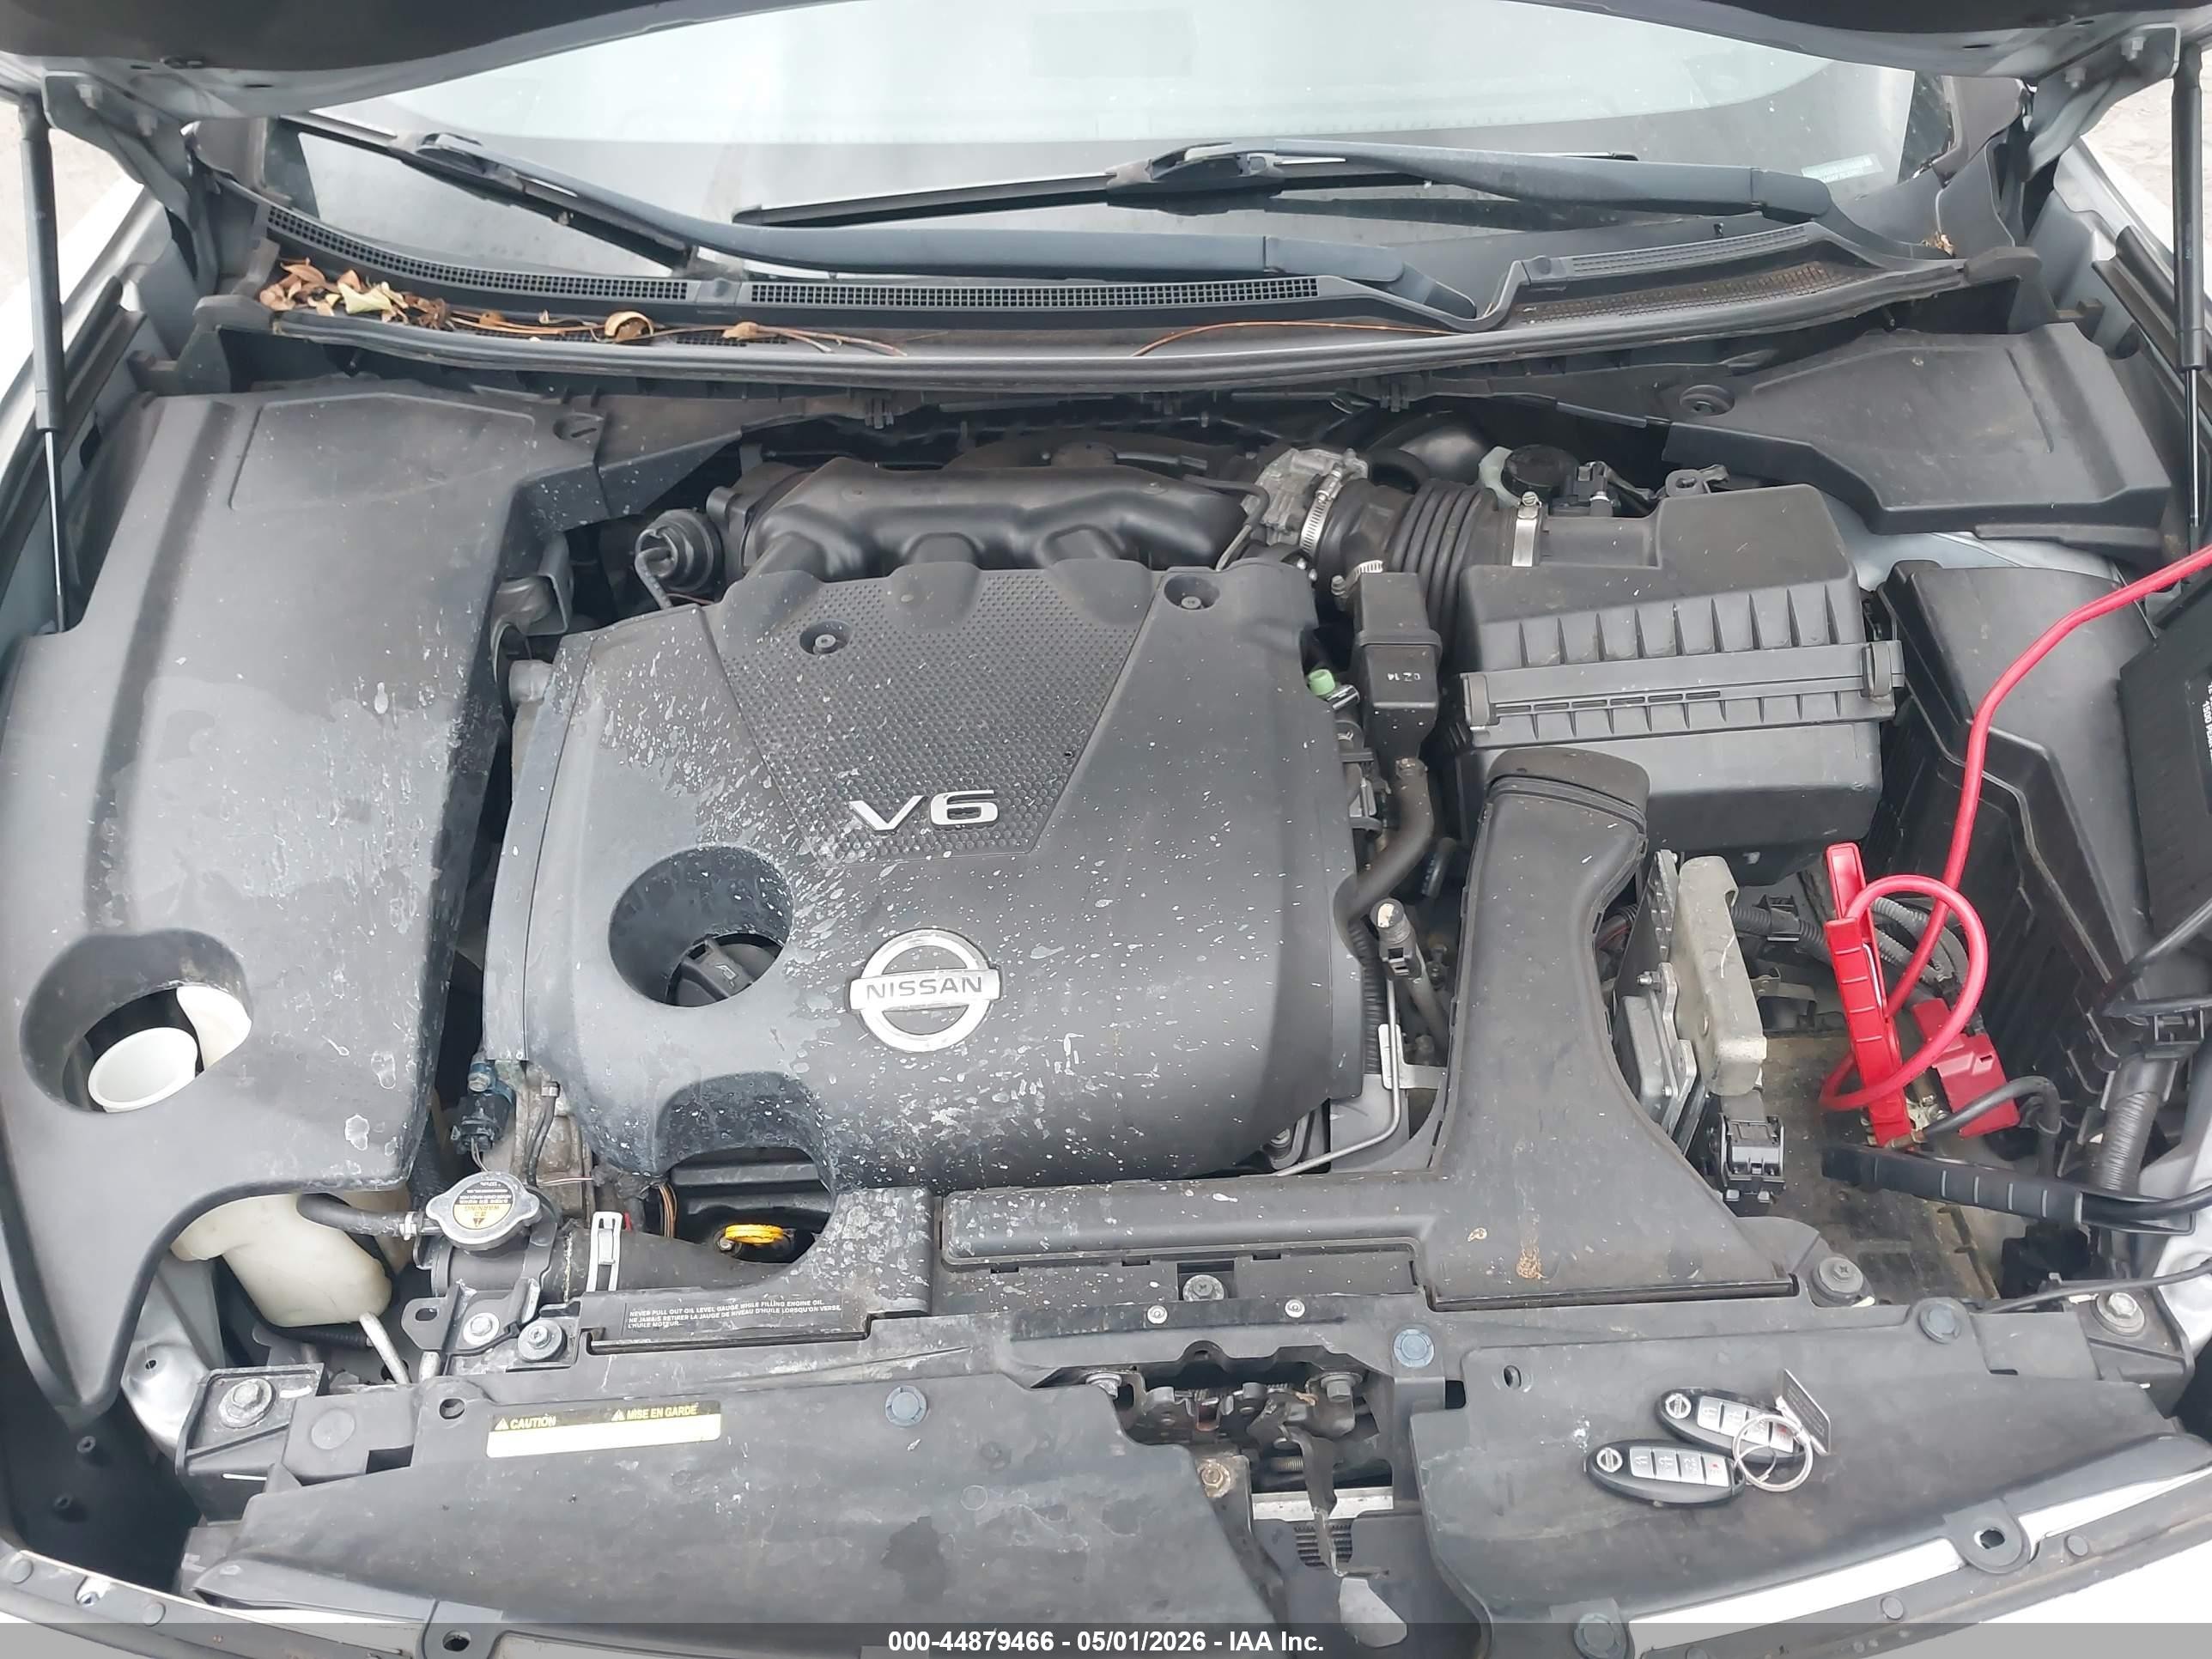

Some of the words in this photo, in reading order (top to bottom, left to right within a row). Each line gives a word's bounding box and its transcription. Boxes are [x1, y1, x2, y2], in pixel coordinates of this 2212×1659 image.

[848, 789, 999, 831] V6
[866, 975, 982, 1001] NISSAN
[510, 1415, 556, 1430] CAUTION
[627, 1408, 648, 1420] MISE
[651, 1407, 664, 1419] EN
[665, 1406, 697, 1418] GARDE
